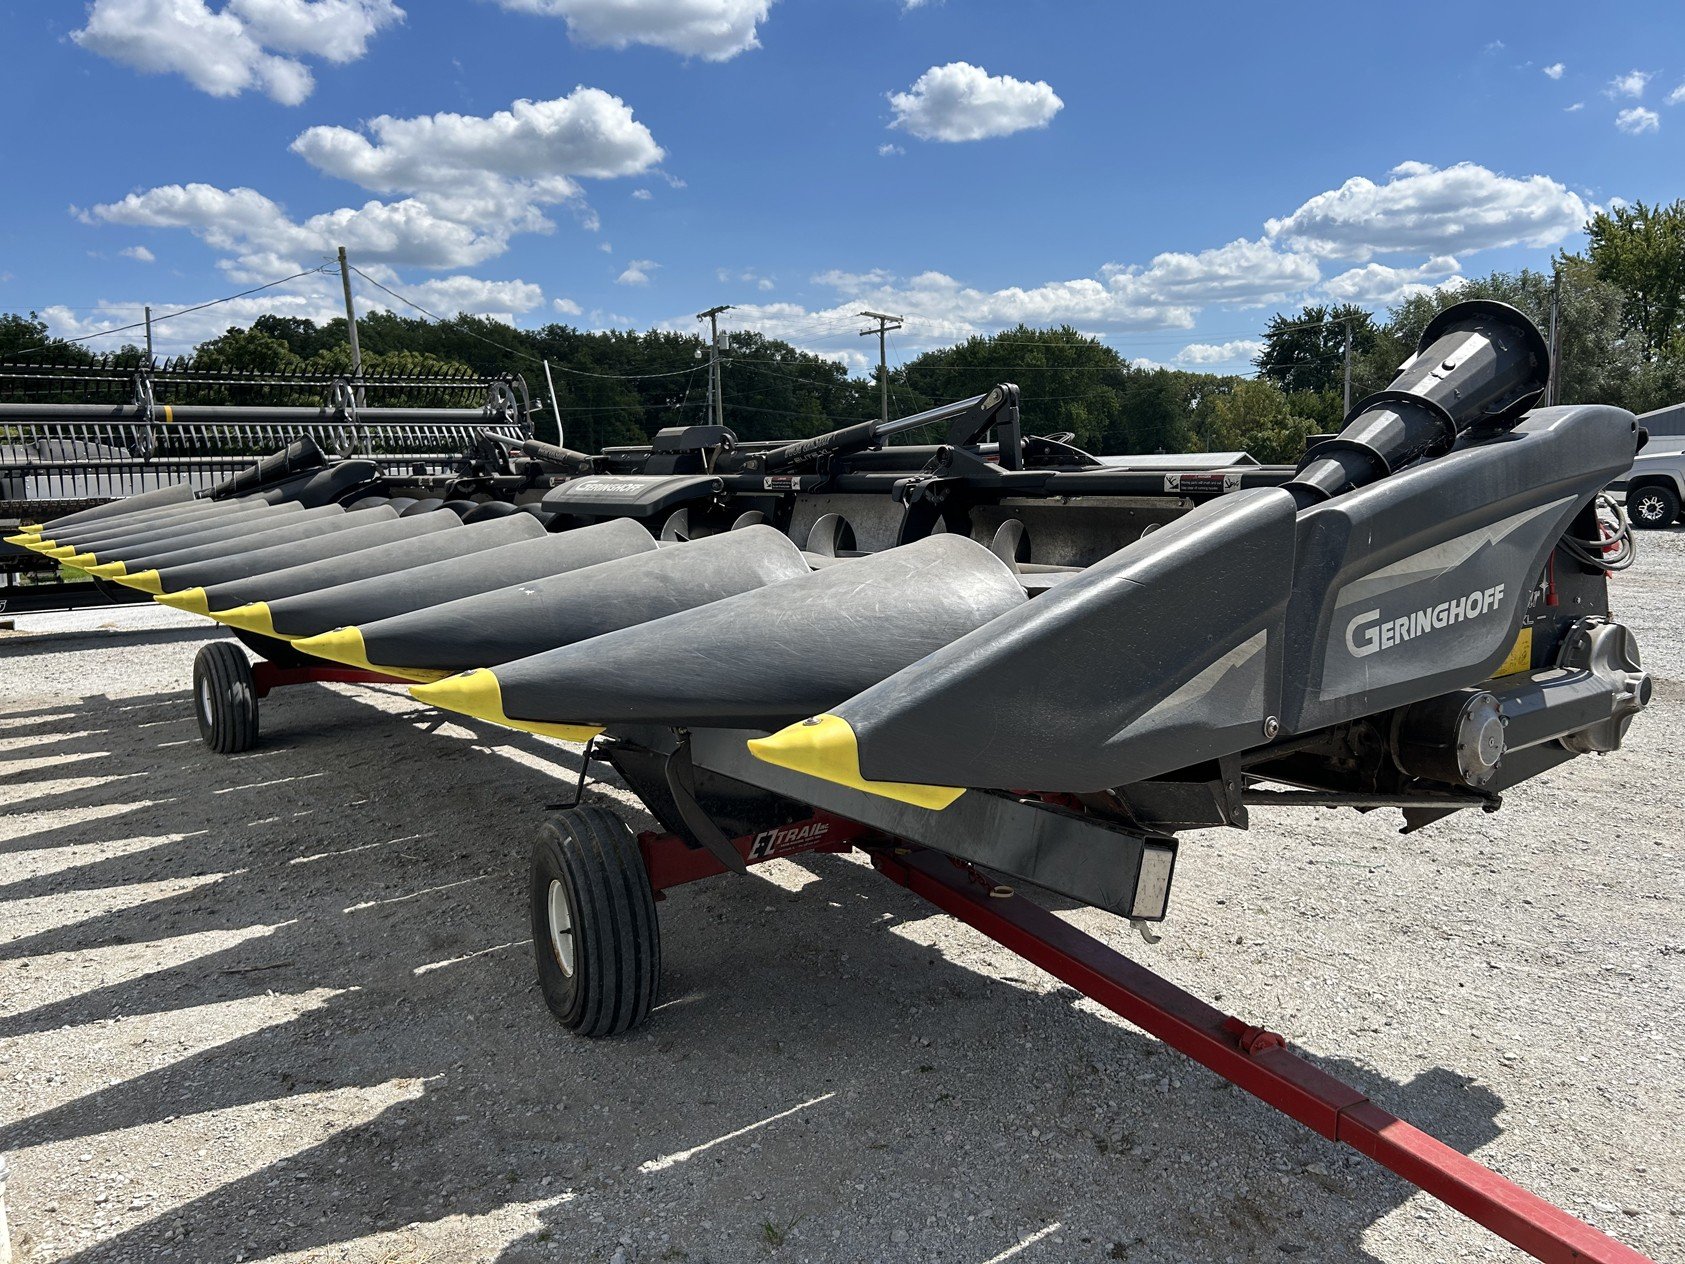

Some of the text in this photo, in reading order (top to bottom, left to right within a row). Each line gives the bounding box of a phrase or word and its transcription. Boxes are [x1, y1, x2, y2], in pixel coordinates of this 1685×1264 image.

[576, 480, 645, 492] GERINGHOFF
[1346, 583, 1505, 658] GERINGHOFF
[776, 823, 828, 844] TRAIL
